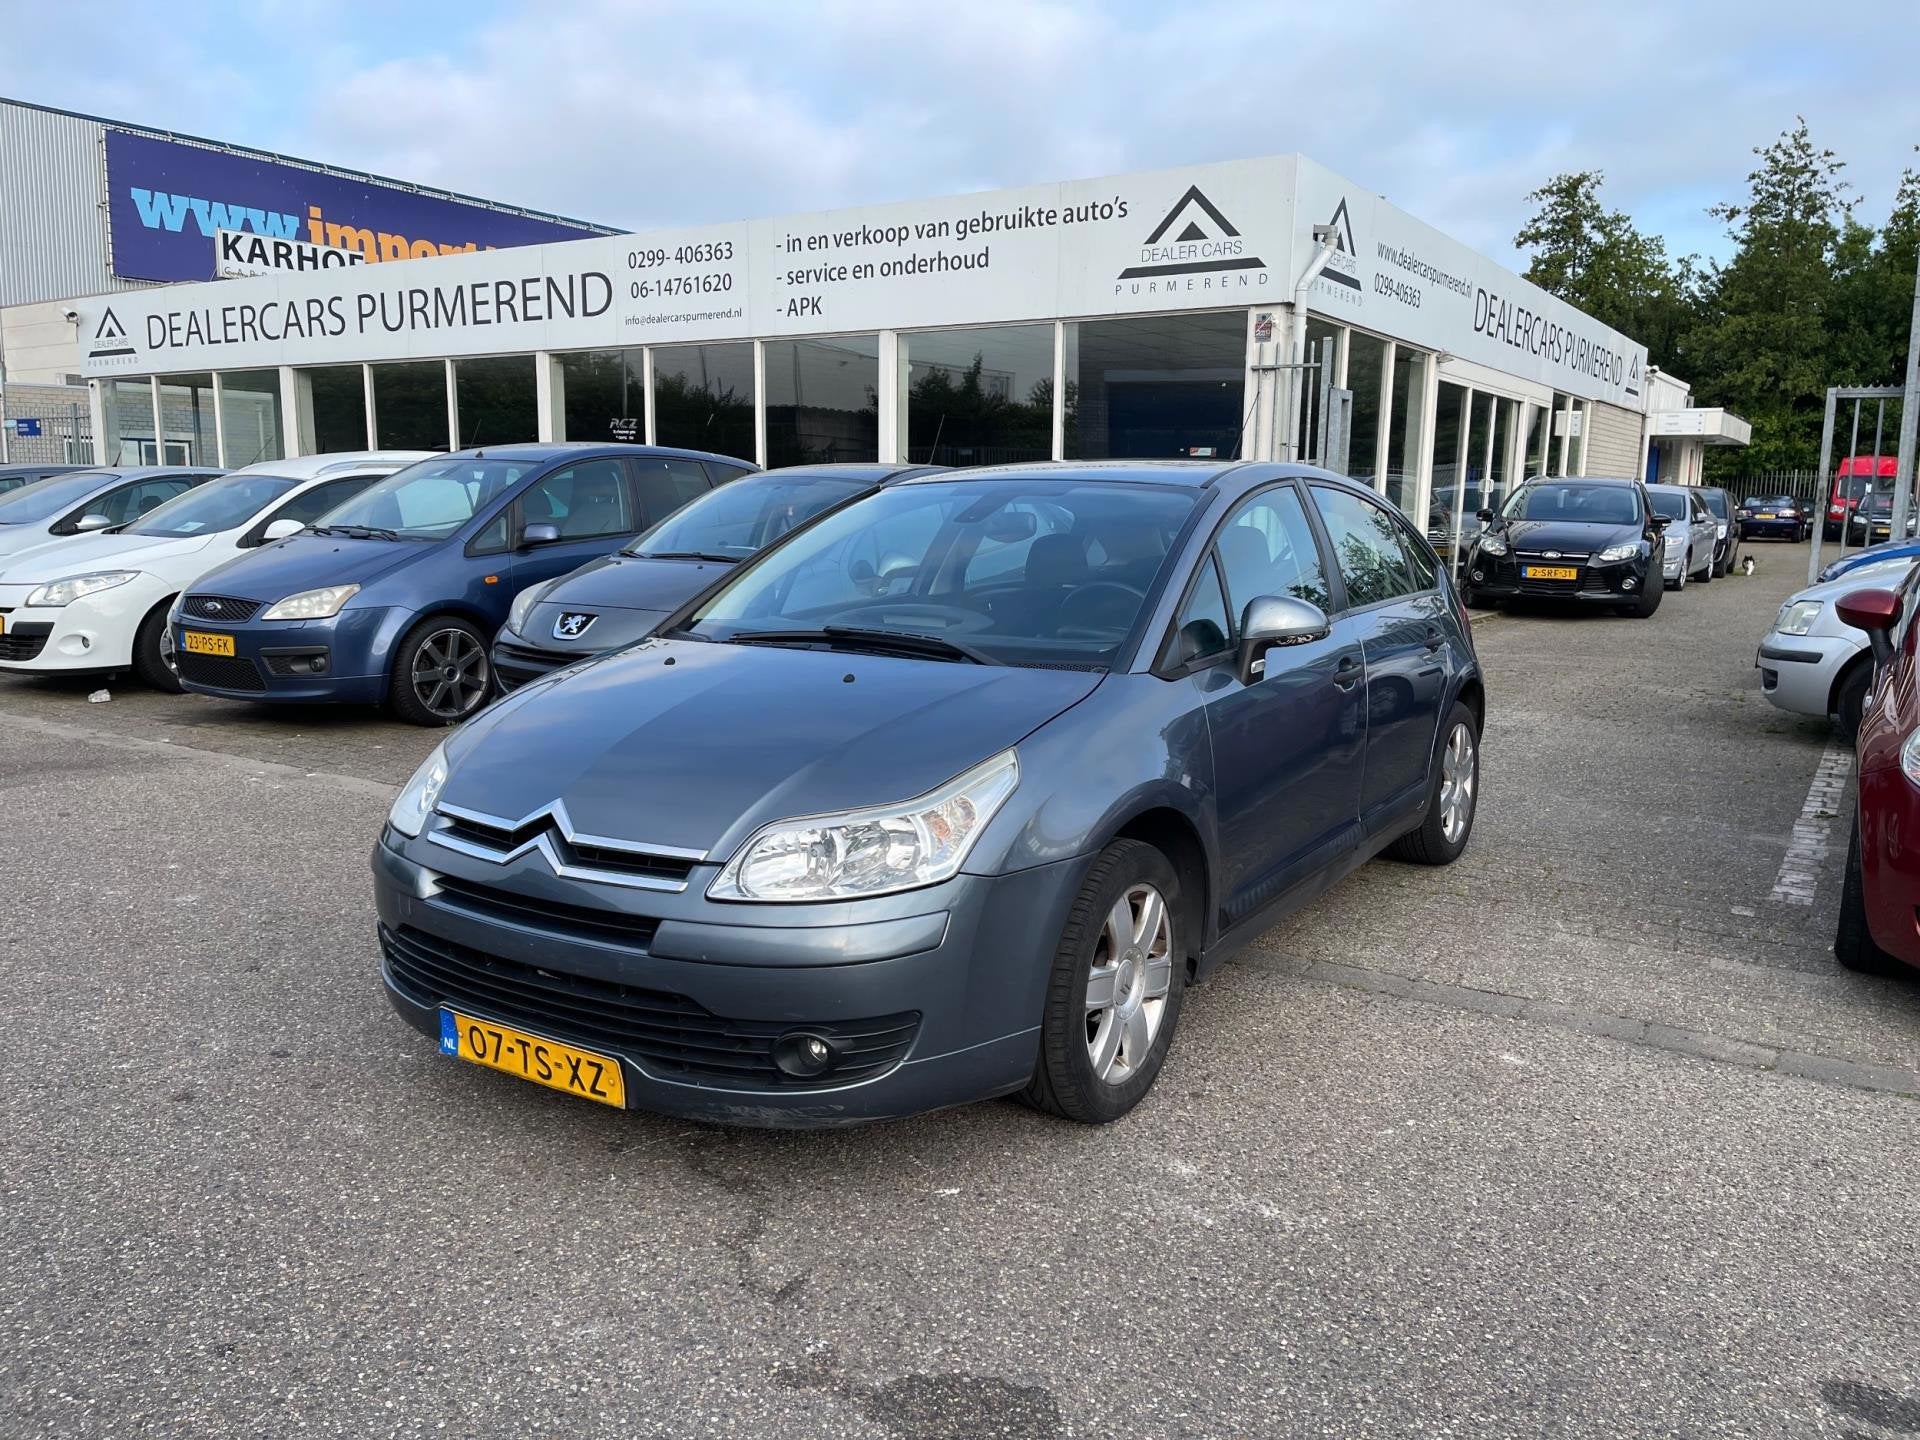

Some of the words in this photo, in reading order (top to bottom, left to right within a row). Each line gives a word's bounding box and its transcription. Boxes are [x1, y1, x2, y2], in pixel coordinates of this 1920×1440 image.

[787, 233, 802, 252] in
[807, 233, 829, 251] en
[833, 224, 909, 247] verkoop
[915, 220, 949, 239] van
[955, 206, 1058, 241] gebruikte
[1062, 196, 1128, 224] auto's
[628, 249, 671, 269] 0299-
[675, 241, 733, 264] 406363
[1141, 244, 1198, 263] DEALER
[1202, 240, 1243, 258] CARS
[787, 262, 848, 285] service
[852, 262, 875, 280] en
[880, 246, 989, 278] onderhoud
[1377, 241, 1473, 299] www.dealercarspurmerend.nl
[630, 272, 732, 299] 06-14761620
[1115, 273, 1269, 296] PURMEREND
[1374, 272, 1421, 309] 0299-406363
[146, 296, 346, 350] DEALERCARS
[357, 271, 613, 334] PURMEREND
[625, 307, 742, 326] info@dealercarspurmerend.nl
[787, 296, 822, 317] APK
[1473, 287, 1564, 364] DEALERCARS
[1564, 331, 1623, 386] PURMEREND
[1532, 568, 1572, 578] 2-SRF-31
[188, 634, 230, 654] 23-PS-FK
[443, 1036, 457, 1050] NL
[468, 1025, 608, 1098] 07-TS-XZ
